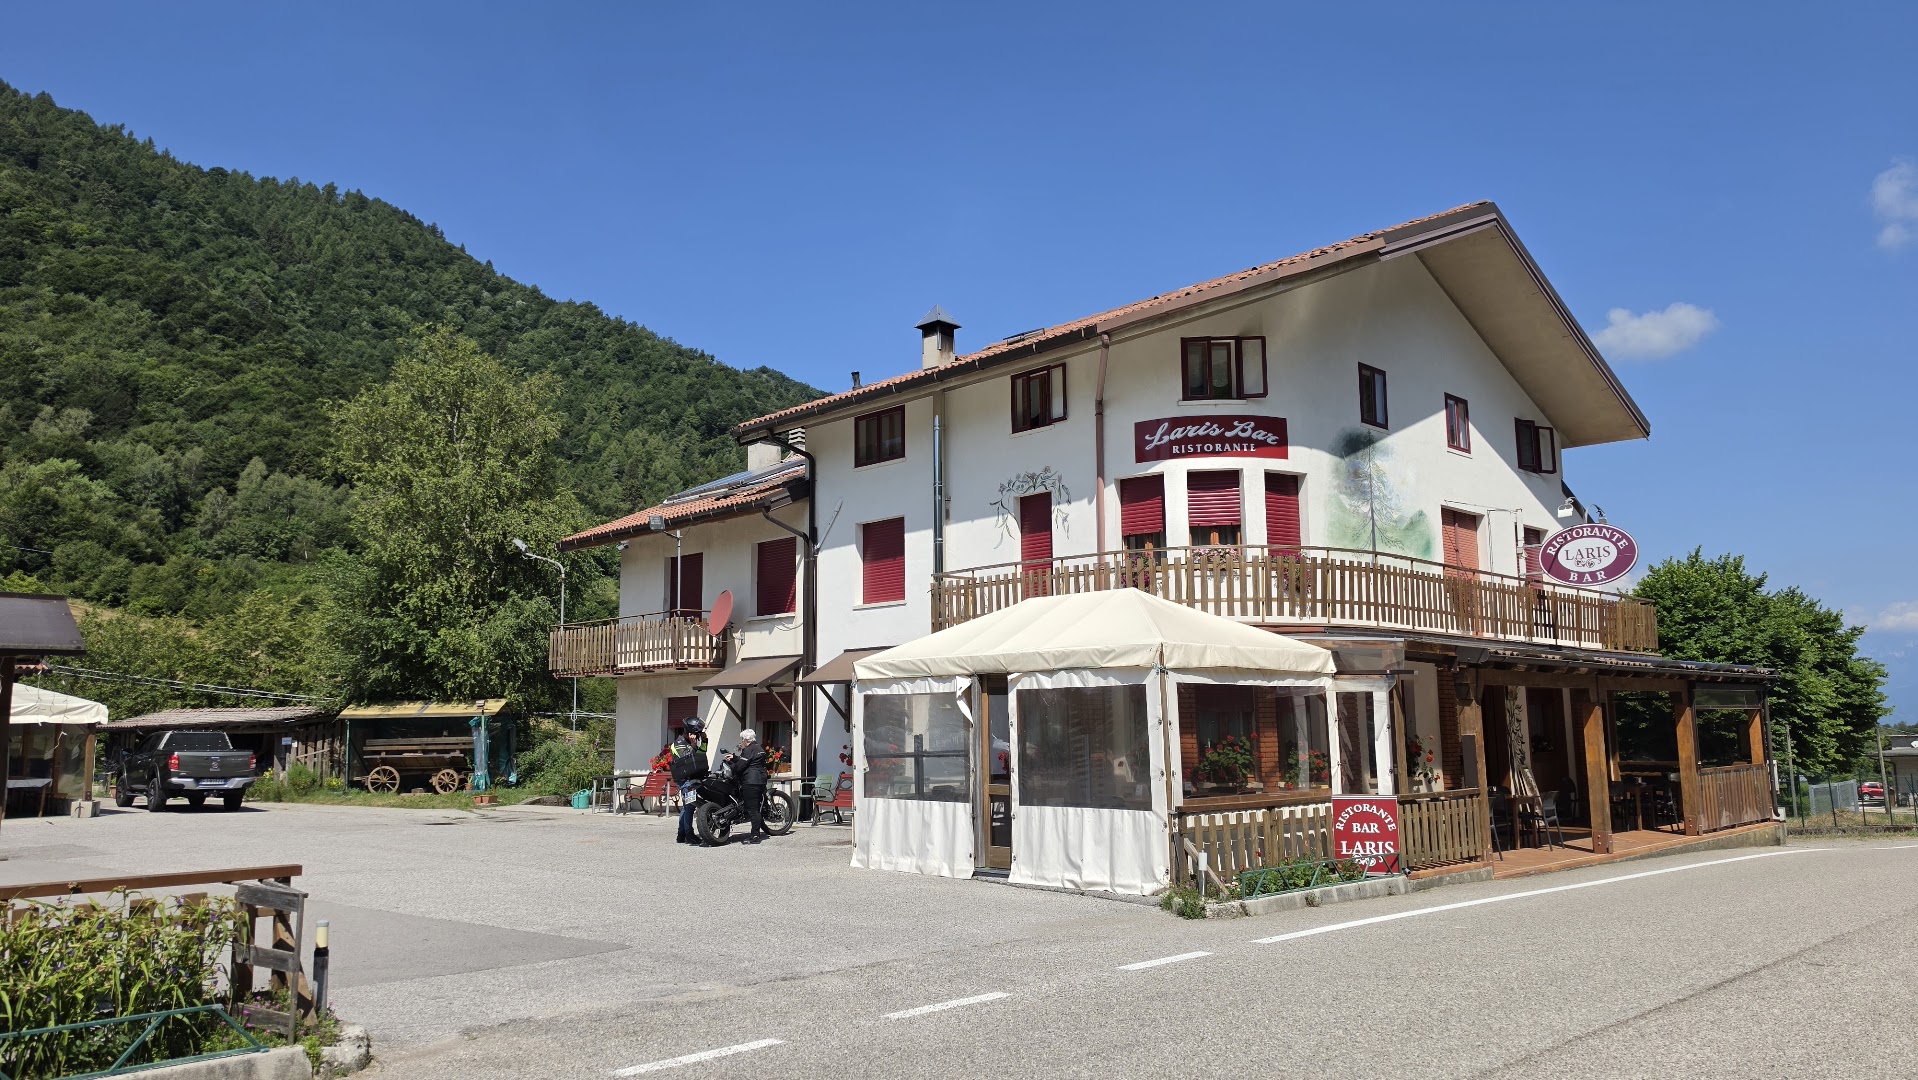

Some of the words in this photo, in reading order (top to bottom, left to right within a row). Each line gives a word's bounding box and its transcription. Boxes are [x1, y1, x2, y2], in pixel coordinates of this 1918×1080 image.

[1145, 421, 1225, 450] Laris
[1225, 420, 1279, 445] Bar
[1172, 443, 1257, 454] RISTORANTE
[1547, 527, 1629, 556] RISTORANTE
[1564, 545, 1611, 561] LARIS
[1569, 570, 1607, 583] BAR
[1335, 803, 1397, 831] RISTORANTE
[1352, 822, 1380, 834] BAR
[1340, 840, 1395, 855] LARIS
